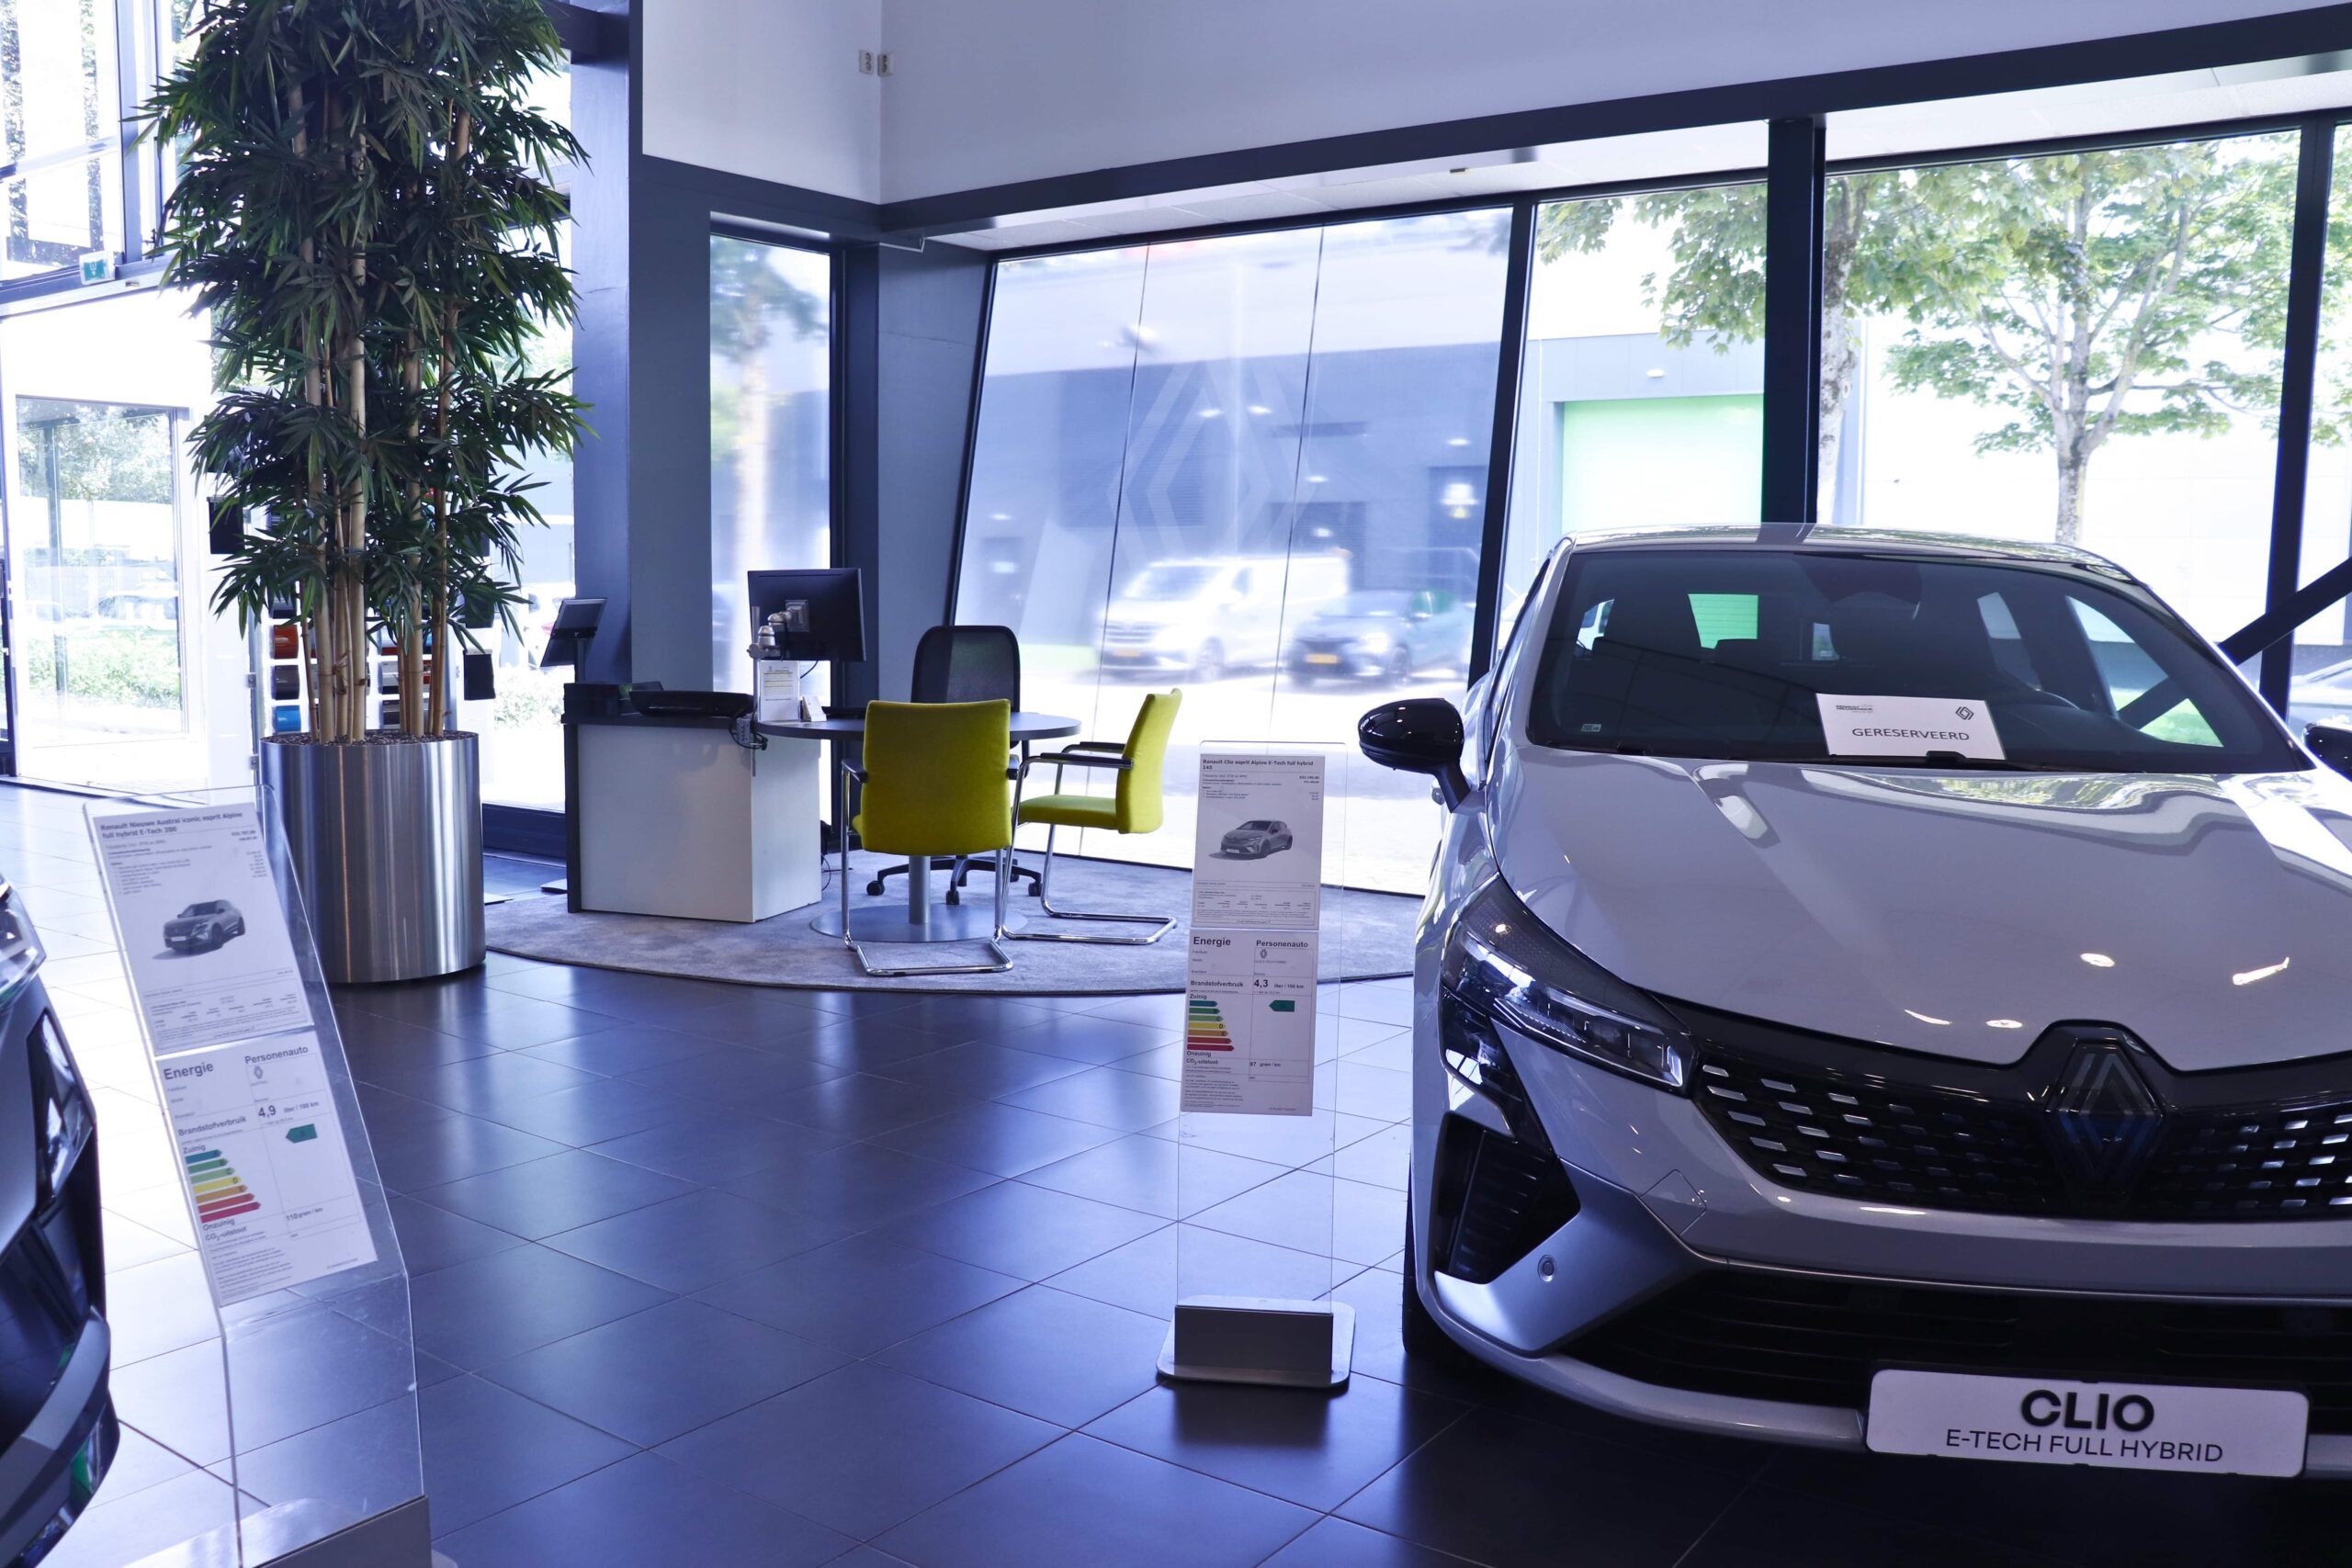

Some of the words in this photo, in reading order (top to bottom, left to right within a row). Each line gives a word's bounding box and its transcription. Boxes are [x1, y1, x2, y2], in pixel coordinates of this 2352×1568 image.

[1851, 728, 1970, 741] GERESERVEERD
[1193, 936, 1231, 948] Energie
[1256, 940, 1308, 948] Personenauto
[1253, 978, 1269, 988] 4,3
[163, 1061, 214, 1080] Energie
[244, 1046, 309, 1065] Personenauto
[178, 1115, 247, 1136] Brandstofverbruik
[257, 1104, 277, 1119] 4,9
[183, 1144, 206, 1155] Zuinig
[202, 1218, 235, 1231] Onzuinig
[2020, 1389, 2154, 1432] CLIO
[1945, 1428, 2041, 1452] E-TECH
[2049, 1436, 2113, 1457] FULL
[2120, 1440, 2223, 1462] HYBRID
